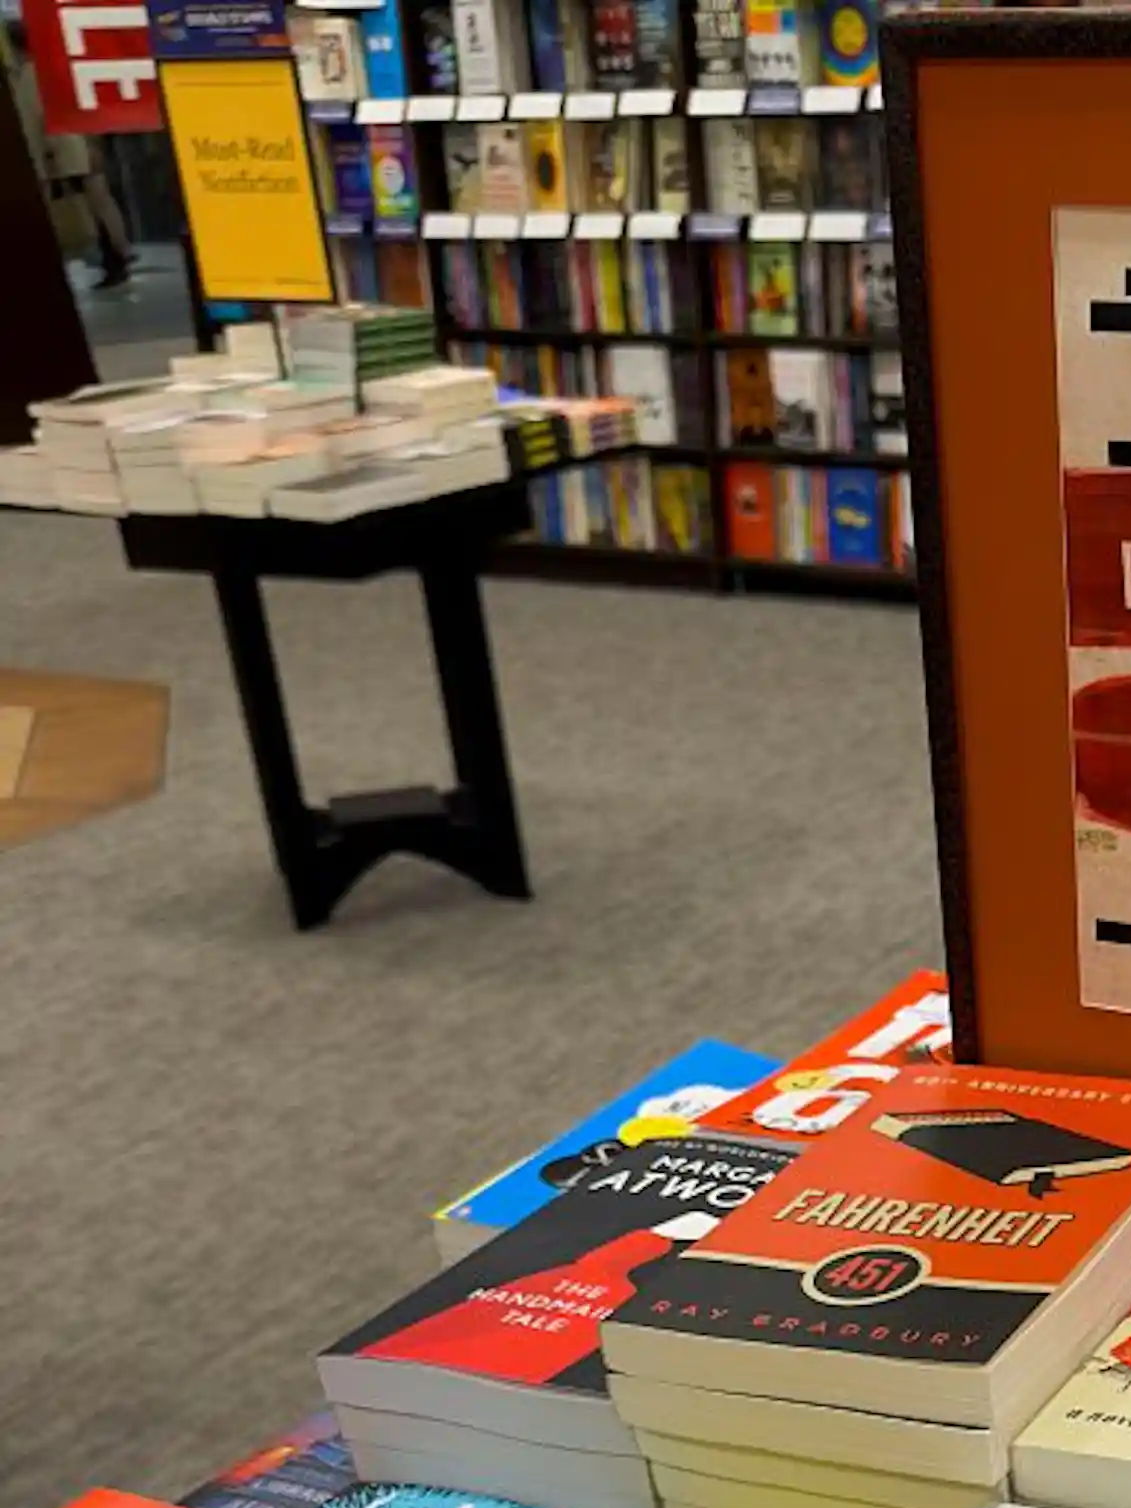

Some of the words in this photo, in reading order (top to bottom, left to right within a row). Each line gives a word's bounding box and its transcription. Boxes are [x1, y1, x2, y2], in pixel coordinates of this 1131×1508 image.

[773, 1189, 1073, 1248] FAHRENHEIT
[552, 1277, 609, 1301] THE
[823, 1256, 904, 1293] 451
[501, 1308, 570, 1333] TALE
[649, 1299, 729, 1321] RAY
[751, 1312, 983, 1348] BRADBURY
[1065, 1407, 1083, 1420] a
